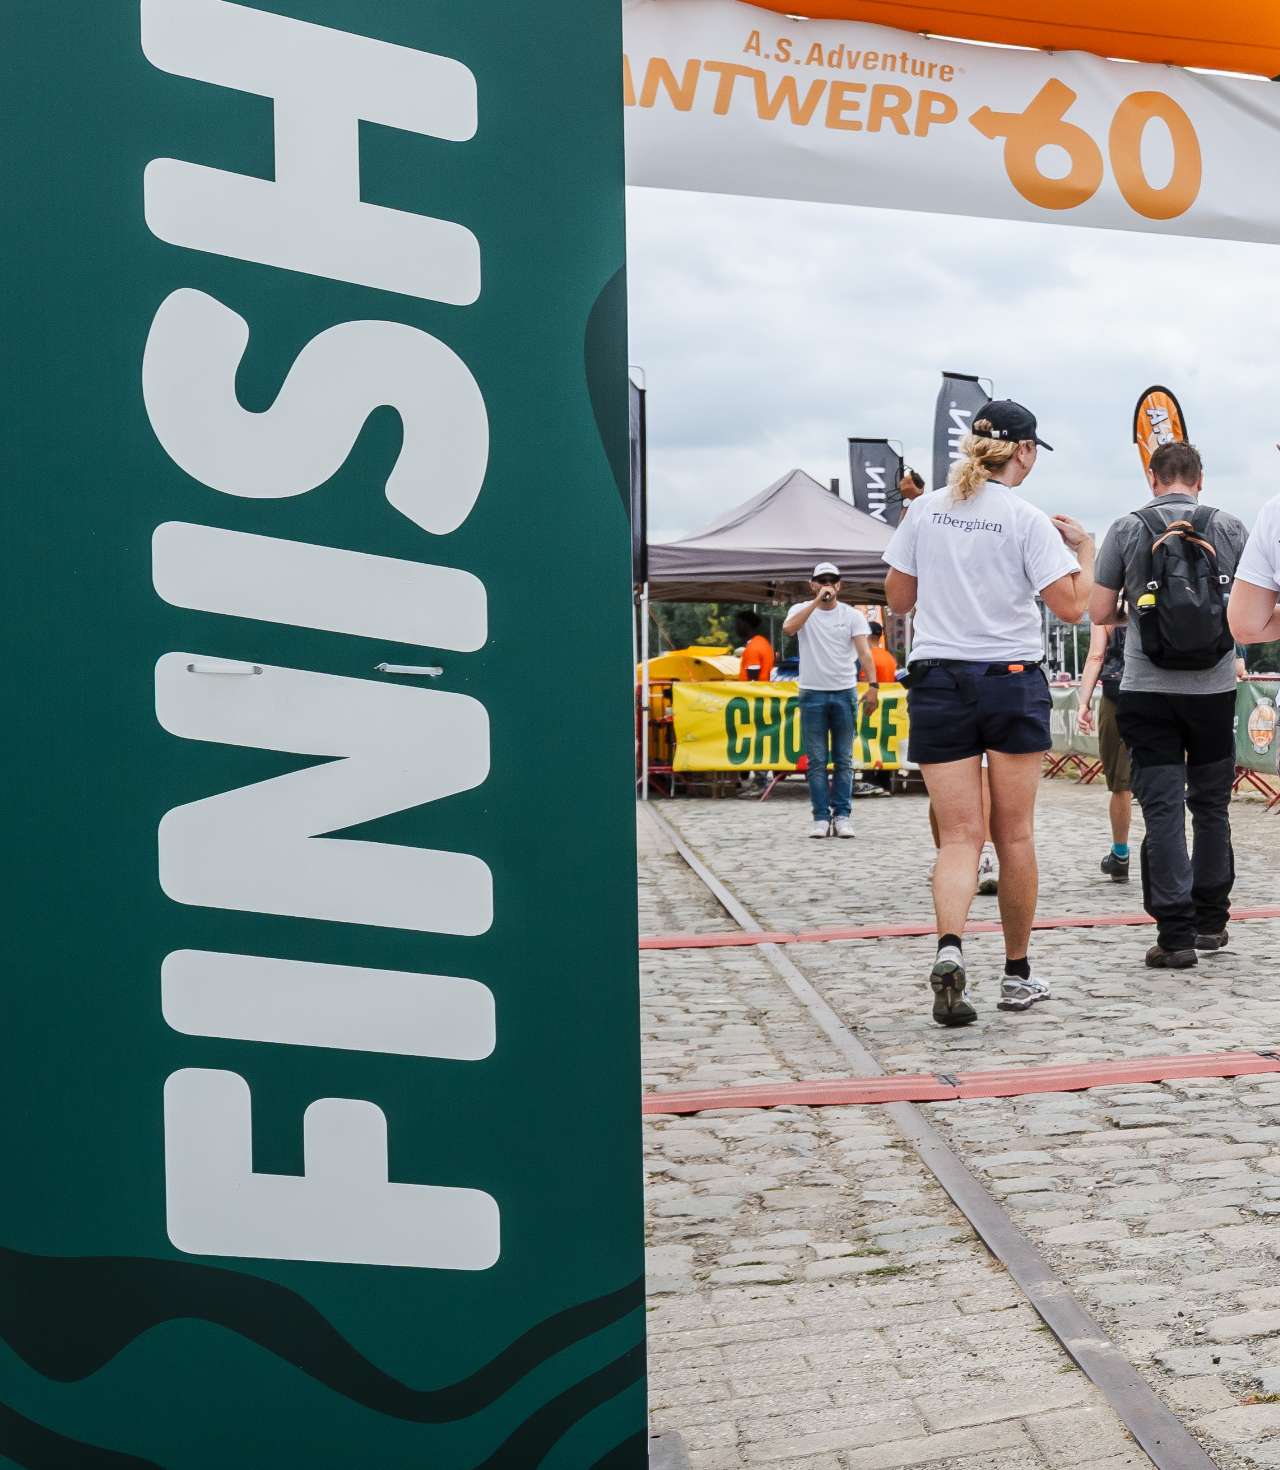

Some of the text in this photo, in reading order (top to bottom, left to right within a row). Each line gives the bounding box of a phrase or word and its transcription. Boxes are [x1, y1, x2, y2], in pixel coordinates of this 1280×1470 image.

[742, 29, 956, 83] A.S.Adventure
[968, 77, 1202, 221] 60
[139, 0, 502, 1272] FINISH
[725, 695, 898, 765] CHOFE
